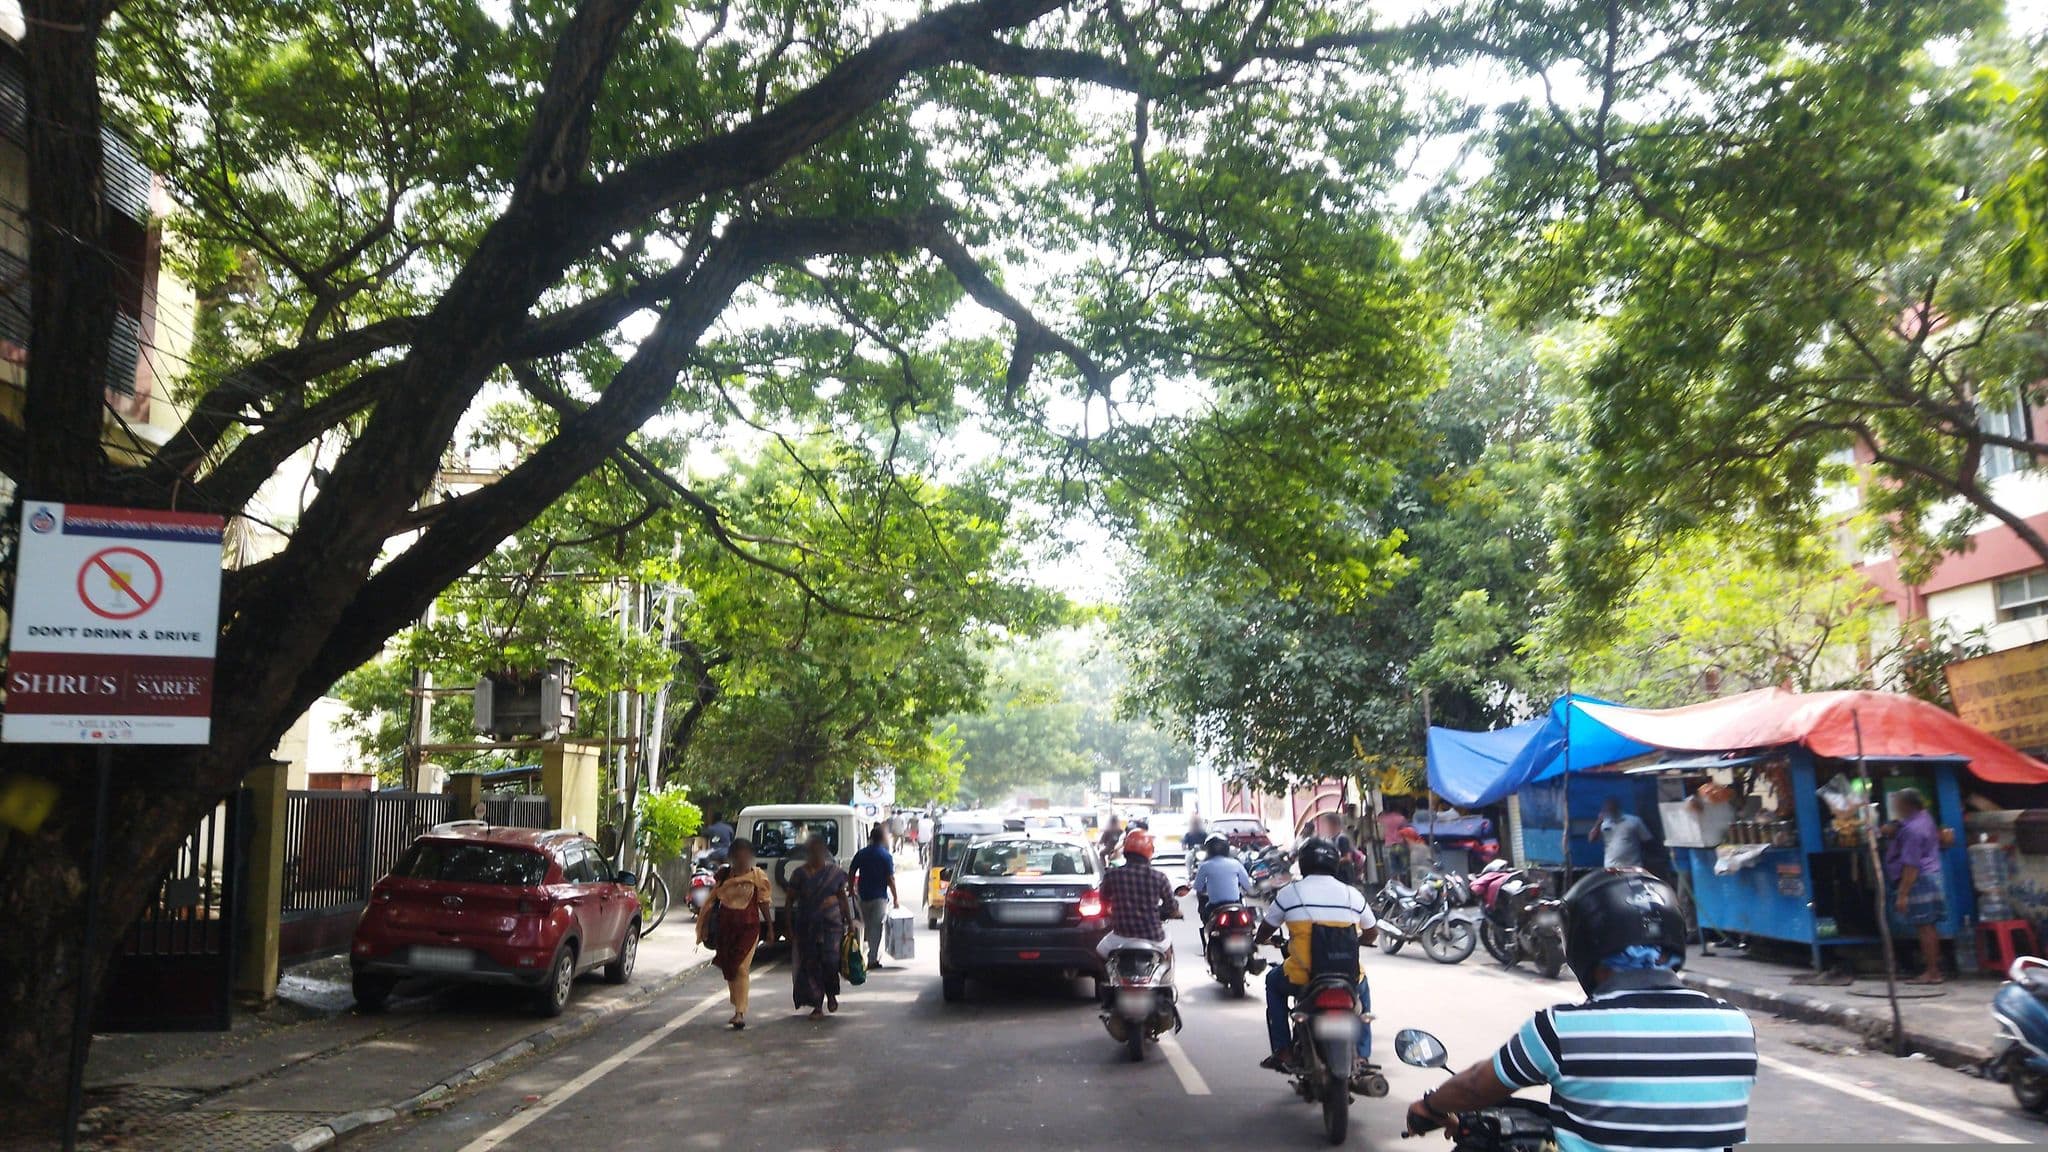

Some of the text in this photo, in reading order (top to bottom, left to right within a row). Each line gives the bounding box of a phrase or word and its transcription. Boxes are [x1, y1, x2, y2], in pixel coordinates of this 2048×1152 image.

[28, 626, 202, 642] DON'T DRINK & DRIVE
